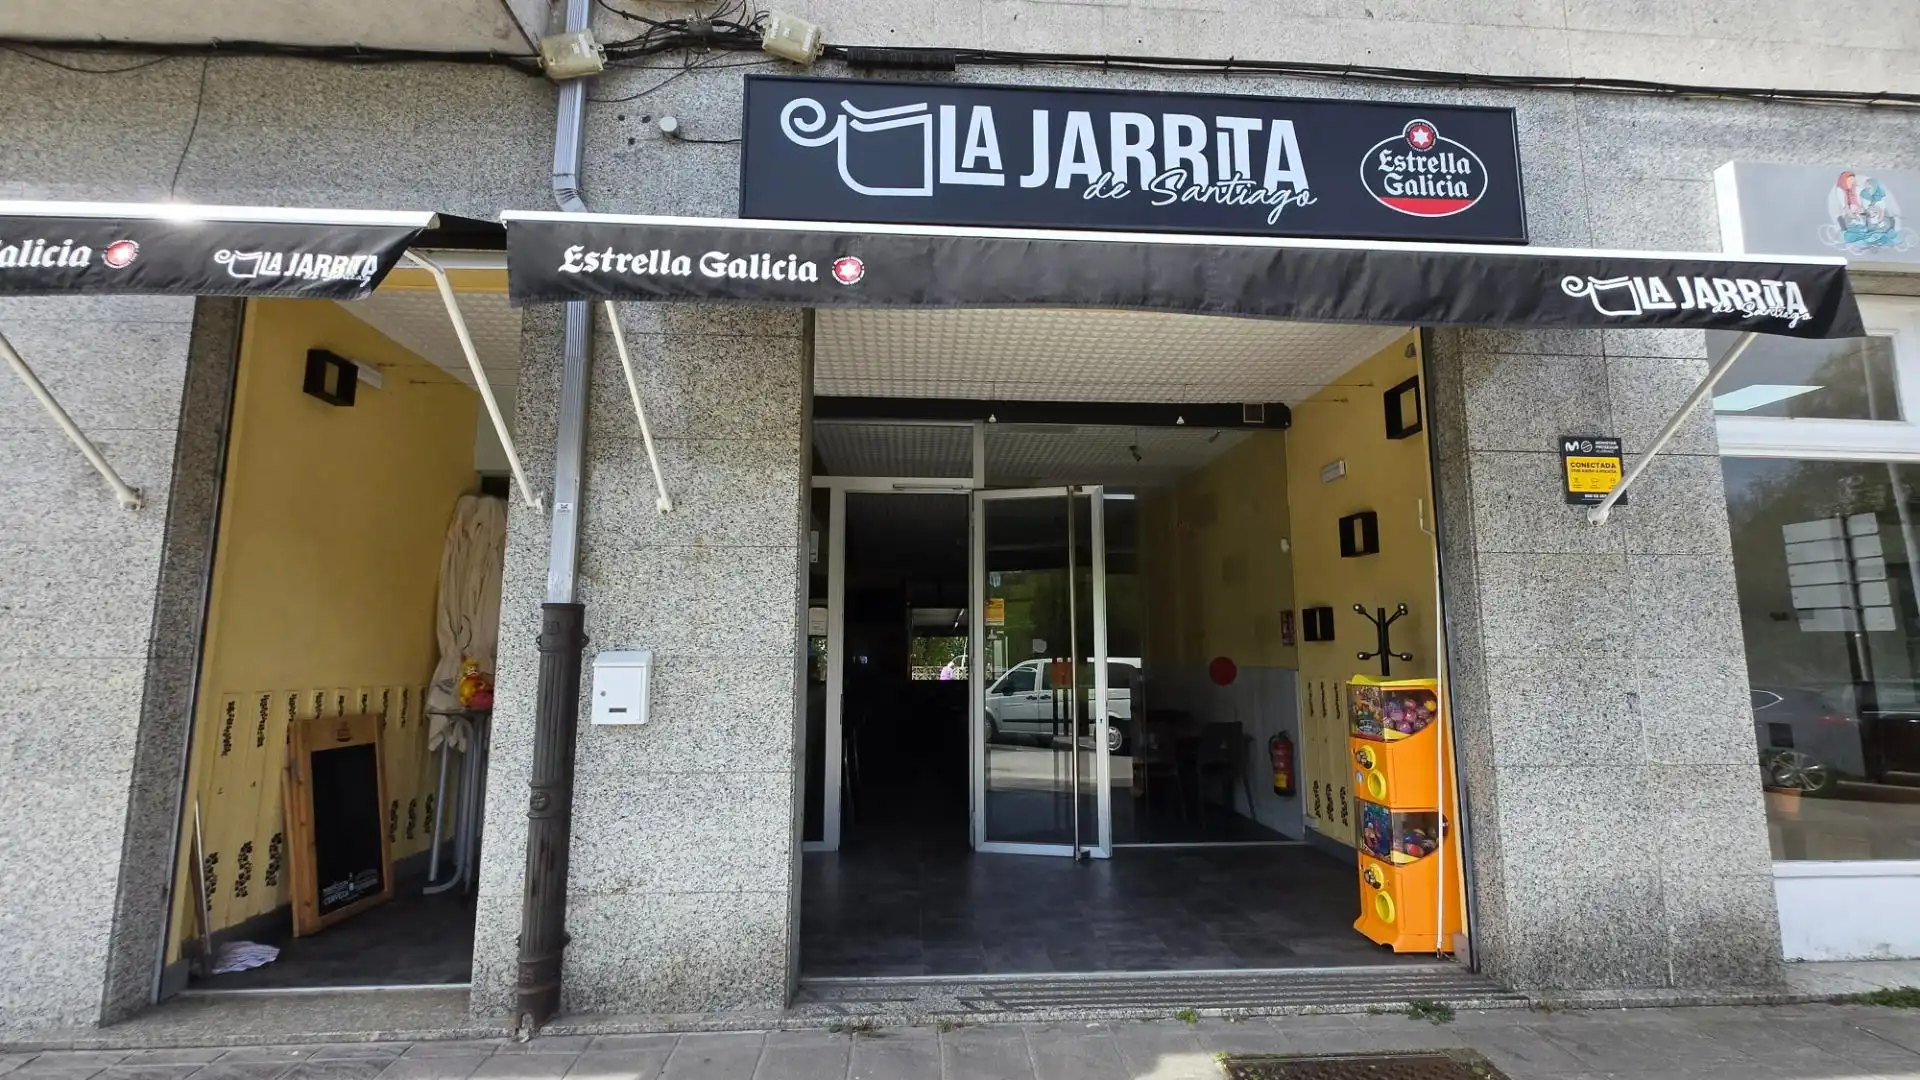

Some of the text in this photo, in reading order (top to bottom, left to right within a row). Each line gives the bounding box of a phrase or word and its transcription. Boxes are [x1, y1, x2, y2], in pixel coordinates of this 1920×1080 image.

[939, 104, 1310, 197] LA JARRITA
[1378, 149, 1472, 175] Estrella
[1083, 168, 1318, 226] de Santiago
[1383, 172, 1470, 198] Galicia
[0, 238, 93, 268] alicia
[259, 251, 283, 277] LA
[557, 244, 692, 277] Estrella
[699, 250, 819, 283] Galicia
[1632, 275, 1809, 314] LA JARRITA
